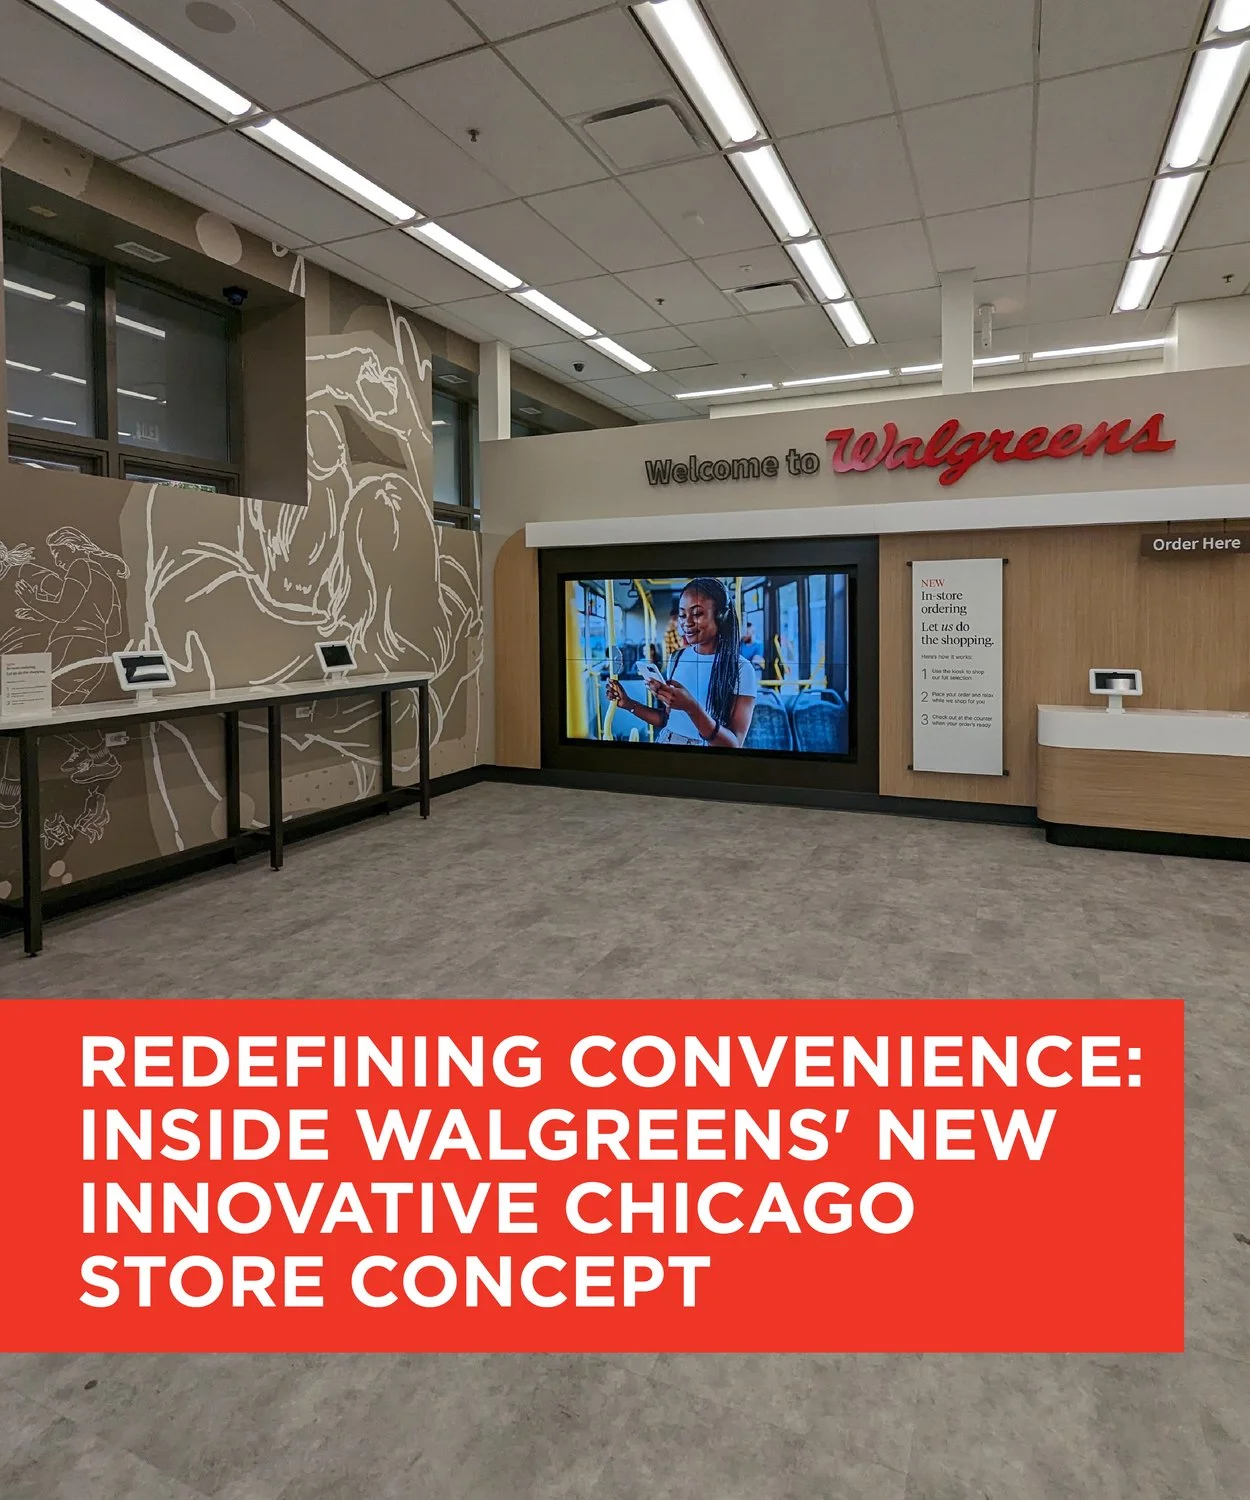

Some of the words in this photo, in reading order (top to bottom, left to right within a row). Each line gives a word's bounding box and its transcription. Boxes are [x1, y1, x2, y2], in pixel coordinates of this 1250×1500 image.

[645, 448, 779, 485] Welcome
[786, 448, 820, 474] to
[825, 412, 1176, 486] Walgreens
[1152, 536, 1198, 552] Order
[1202, 535, 1241, 550] Here
[921, 579, 945, 587] NEW
[921, 591, 963, 600] In-store
[921, 604, 967, 616] ordering
[921, 622, 938, 631] Let
[941, 623, 953, 631] us
[956, 622, 969, 631] do
[921, 635, 938, 644] the
[941, 635, 994, 647] shopping.
[921, 668, 927, 680] 1
[920, 691, 929, 703] 2
[920, 713, 929, 726] 3
